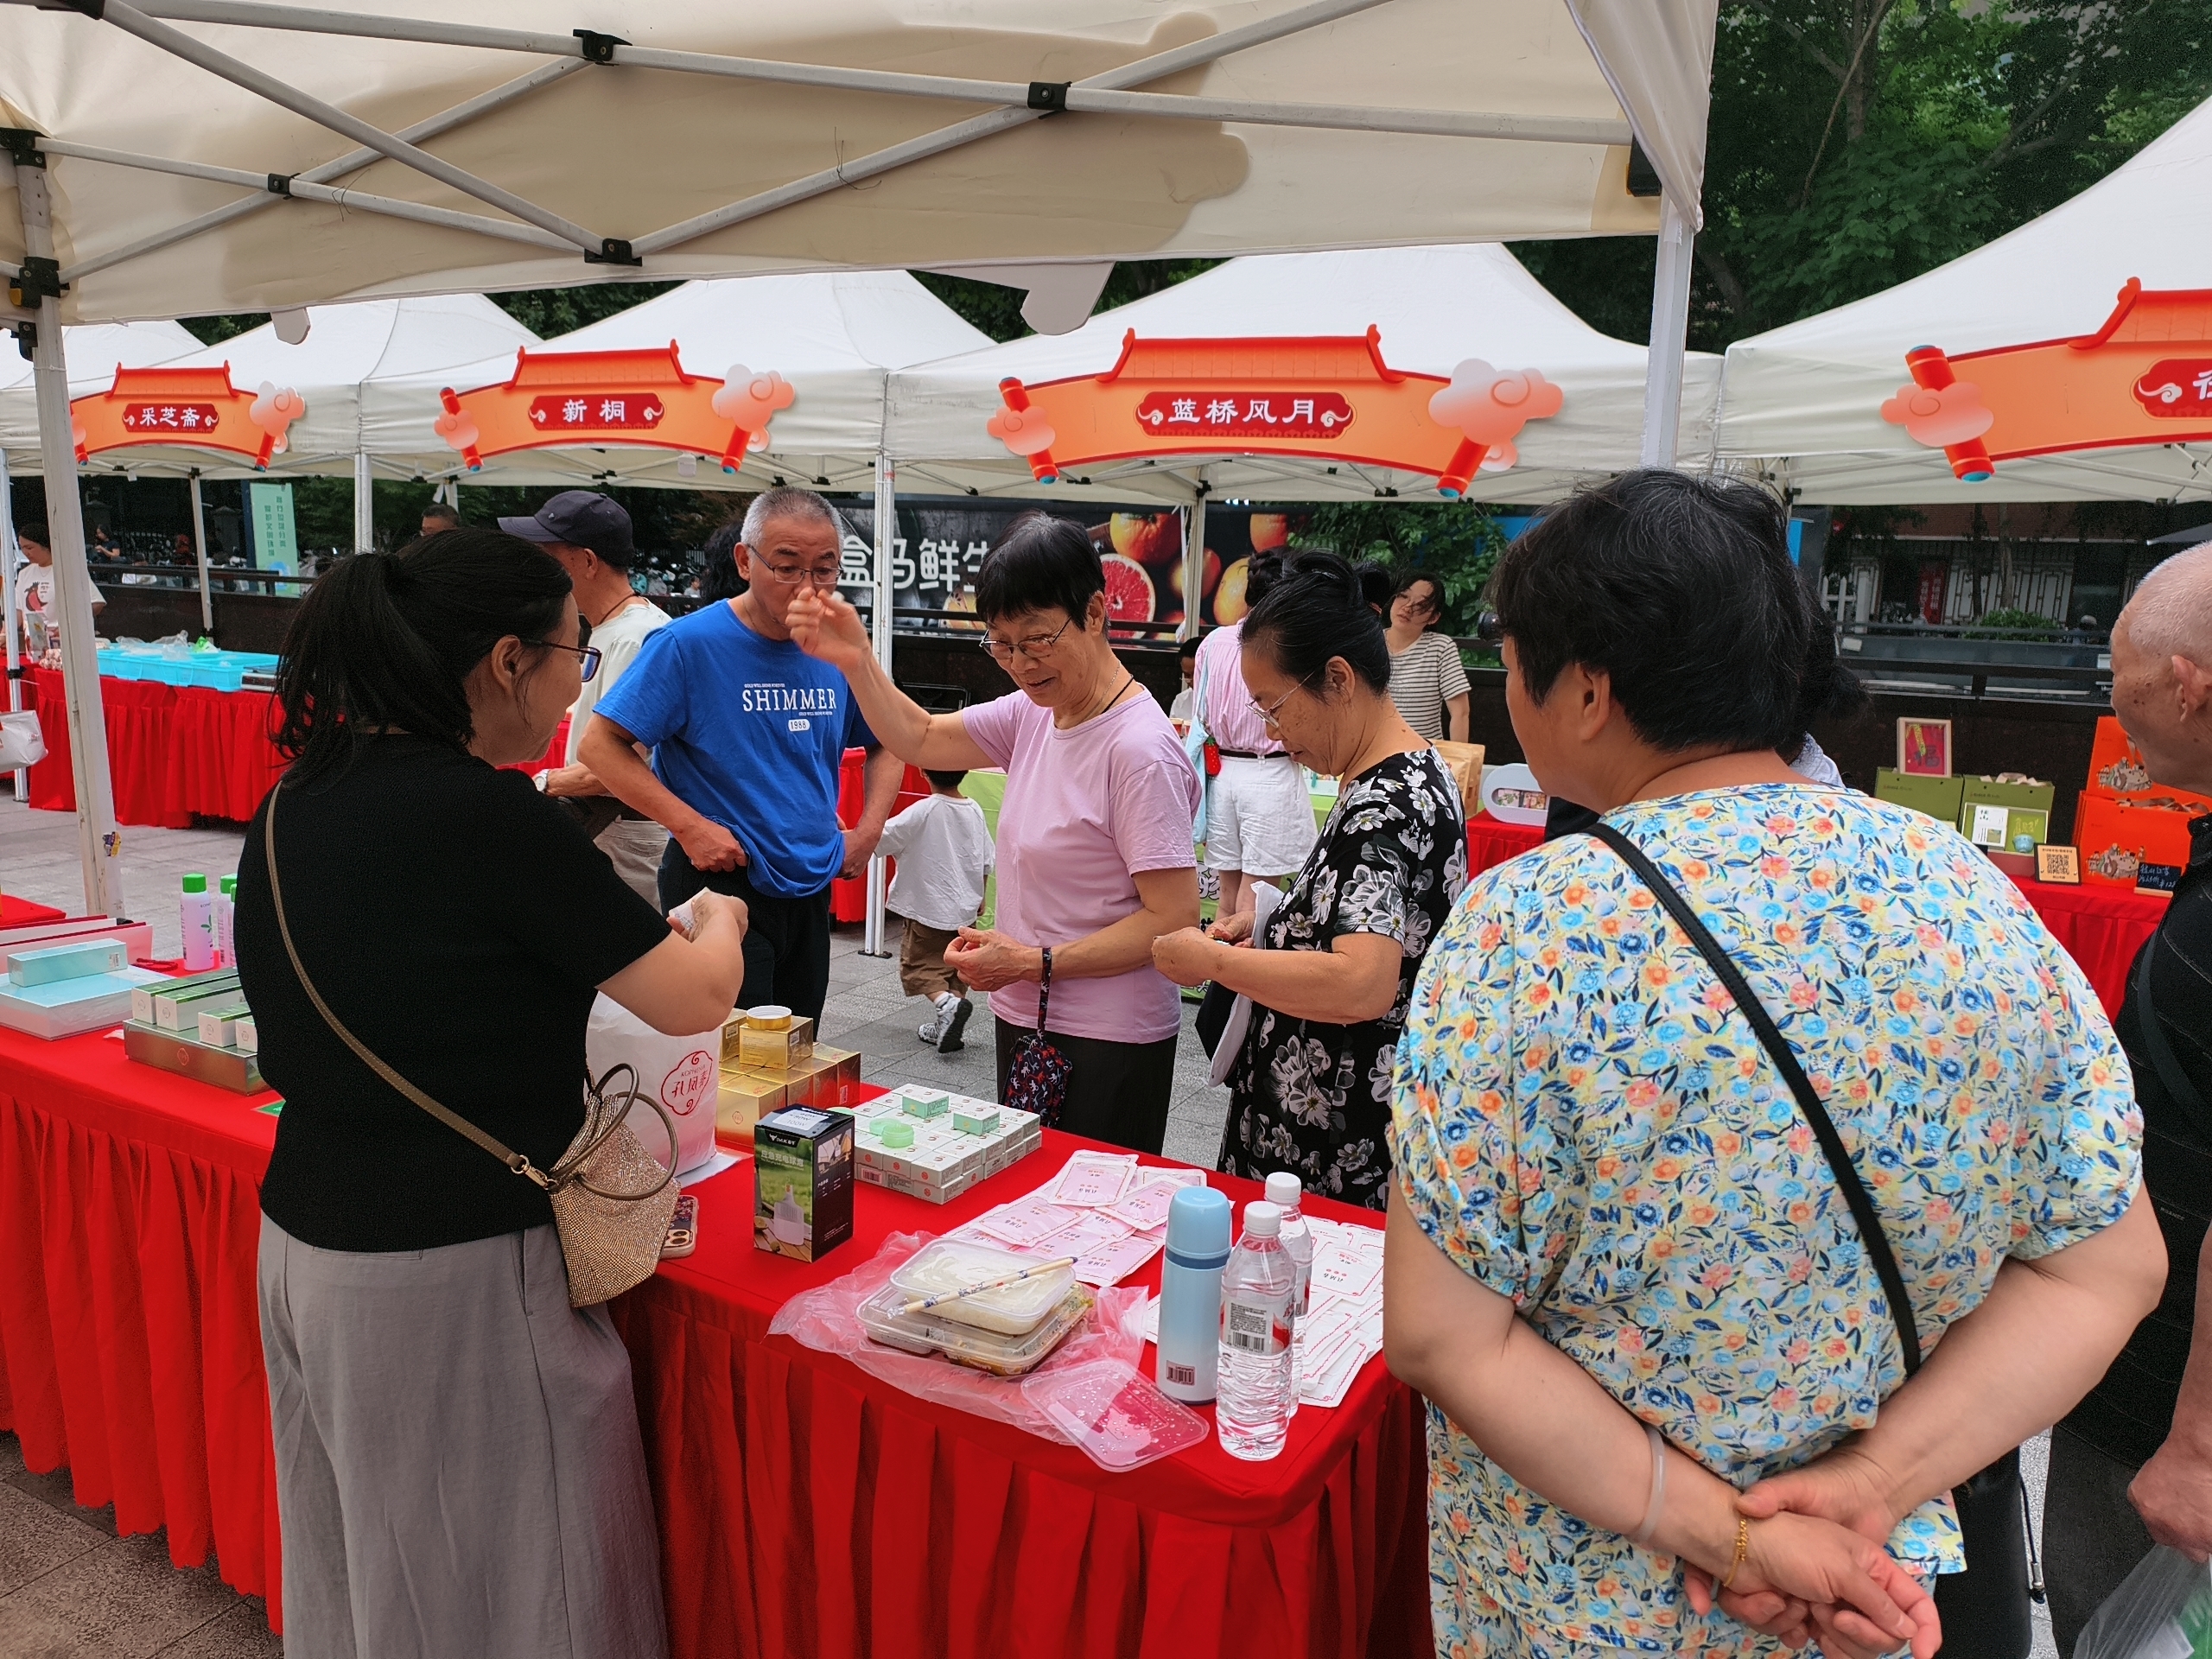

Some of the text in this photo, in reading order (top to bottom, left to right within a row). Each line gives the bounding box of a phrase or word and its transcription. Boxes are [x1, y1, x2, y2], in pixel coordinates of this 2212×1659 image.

[139, 406, 200, 428] 采芝斋
[562, 398, 625, 423] 新桐
[1167, 398, 1314, 424] 蓝桥风月
[741, 688, 837, 712] SHIMMER
